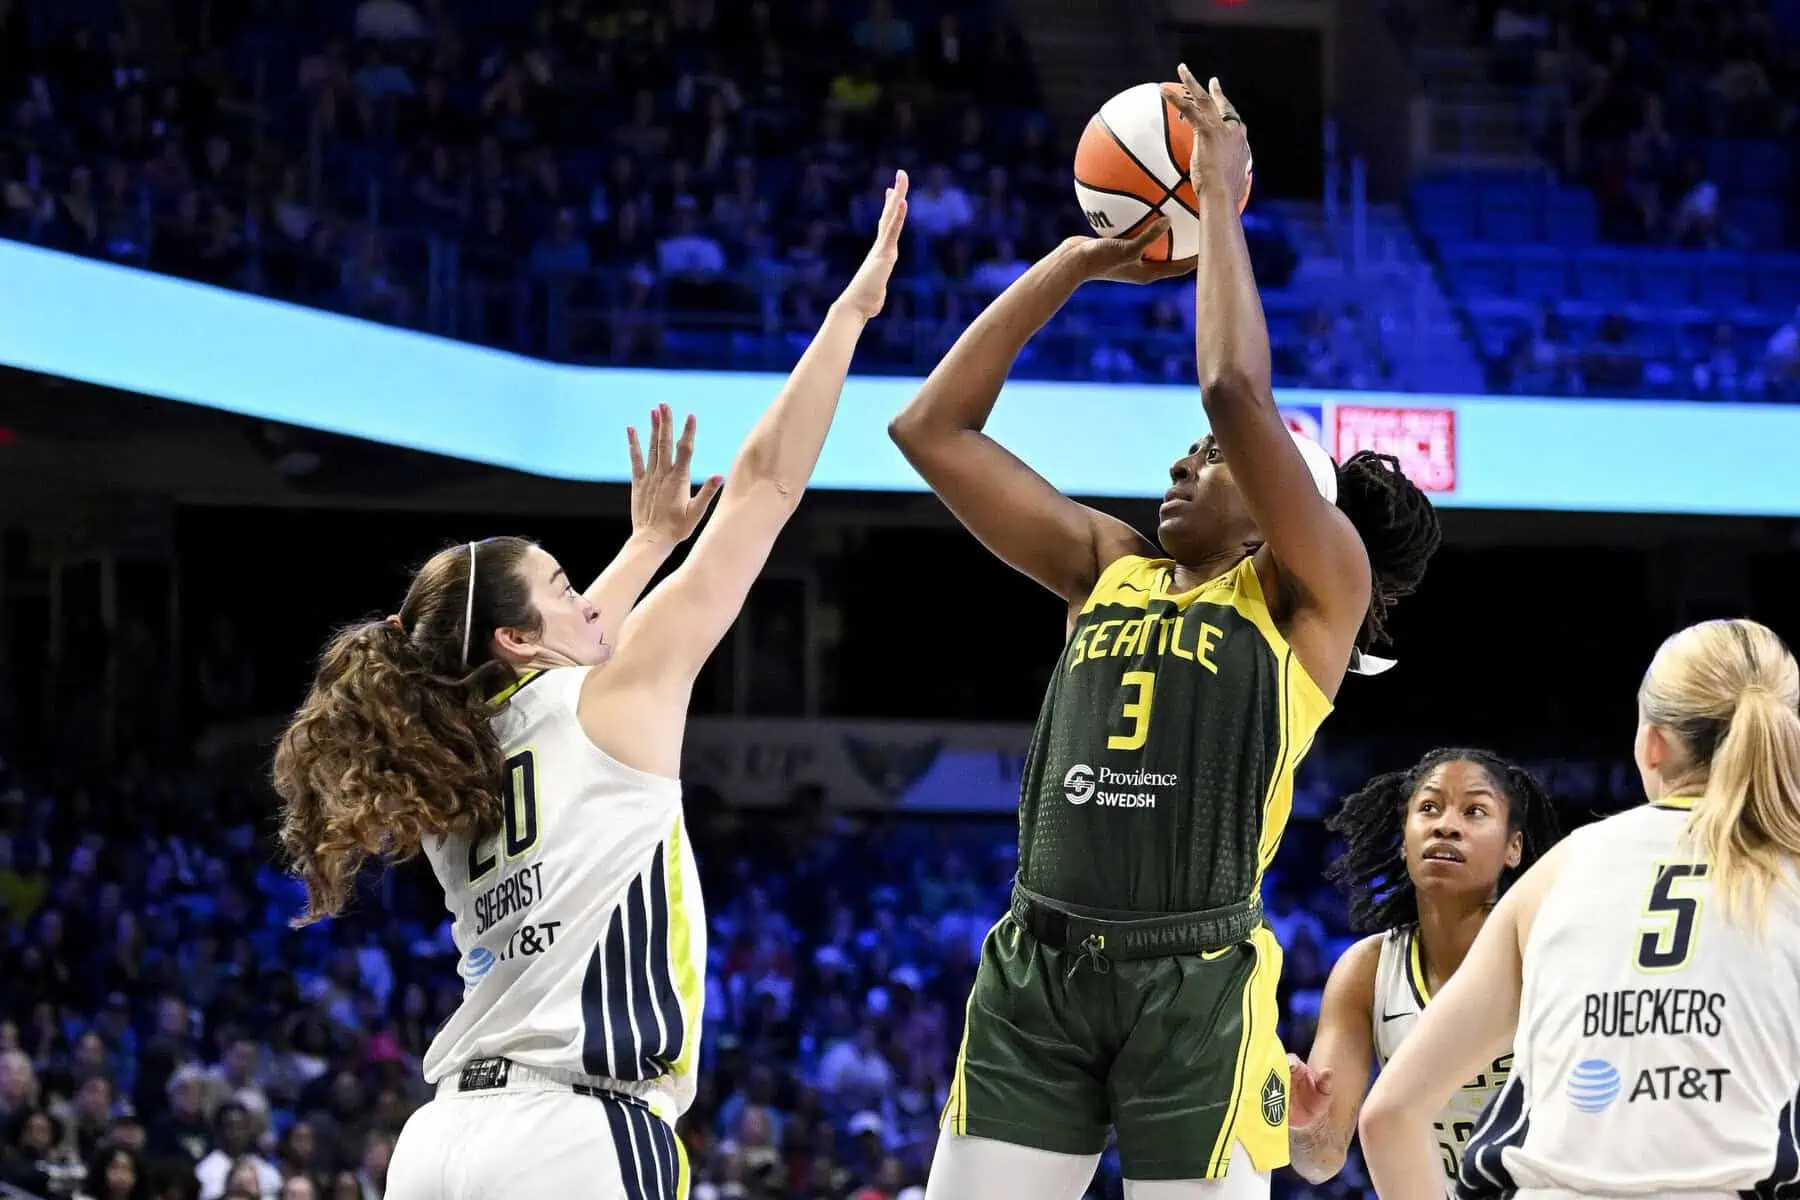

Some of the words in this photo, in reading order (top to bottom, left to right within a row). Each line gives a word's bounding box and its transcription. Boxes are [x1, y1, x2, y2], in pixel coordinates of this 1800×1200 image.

[1070, 613, 1223, 675] SEATTLE
[1107, 671, 1155, 750] 3
[1095, 791, 1156, 809] SWEDSH
[1098, 766, 1177, 787] Providence
[474, 862, 543, 935] SIEGRIST
[1635, 861, 1712, 973] 5
[500, 921, 561, 961] T&T
[1582, 988, 1726, 1038] BUECKERS
[1628, 1065, 1731, 1103] AT&T
